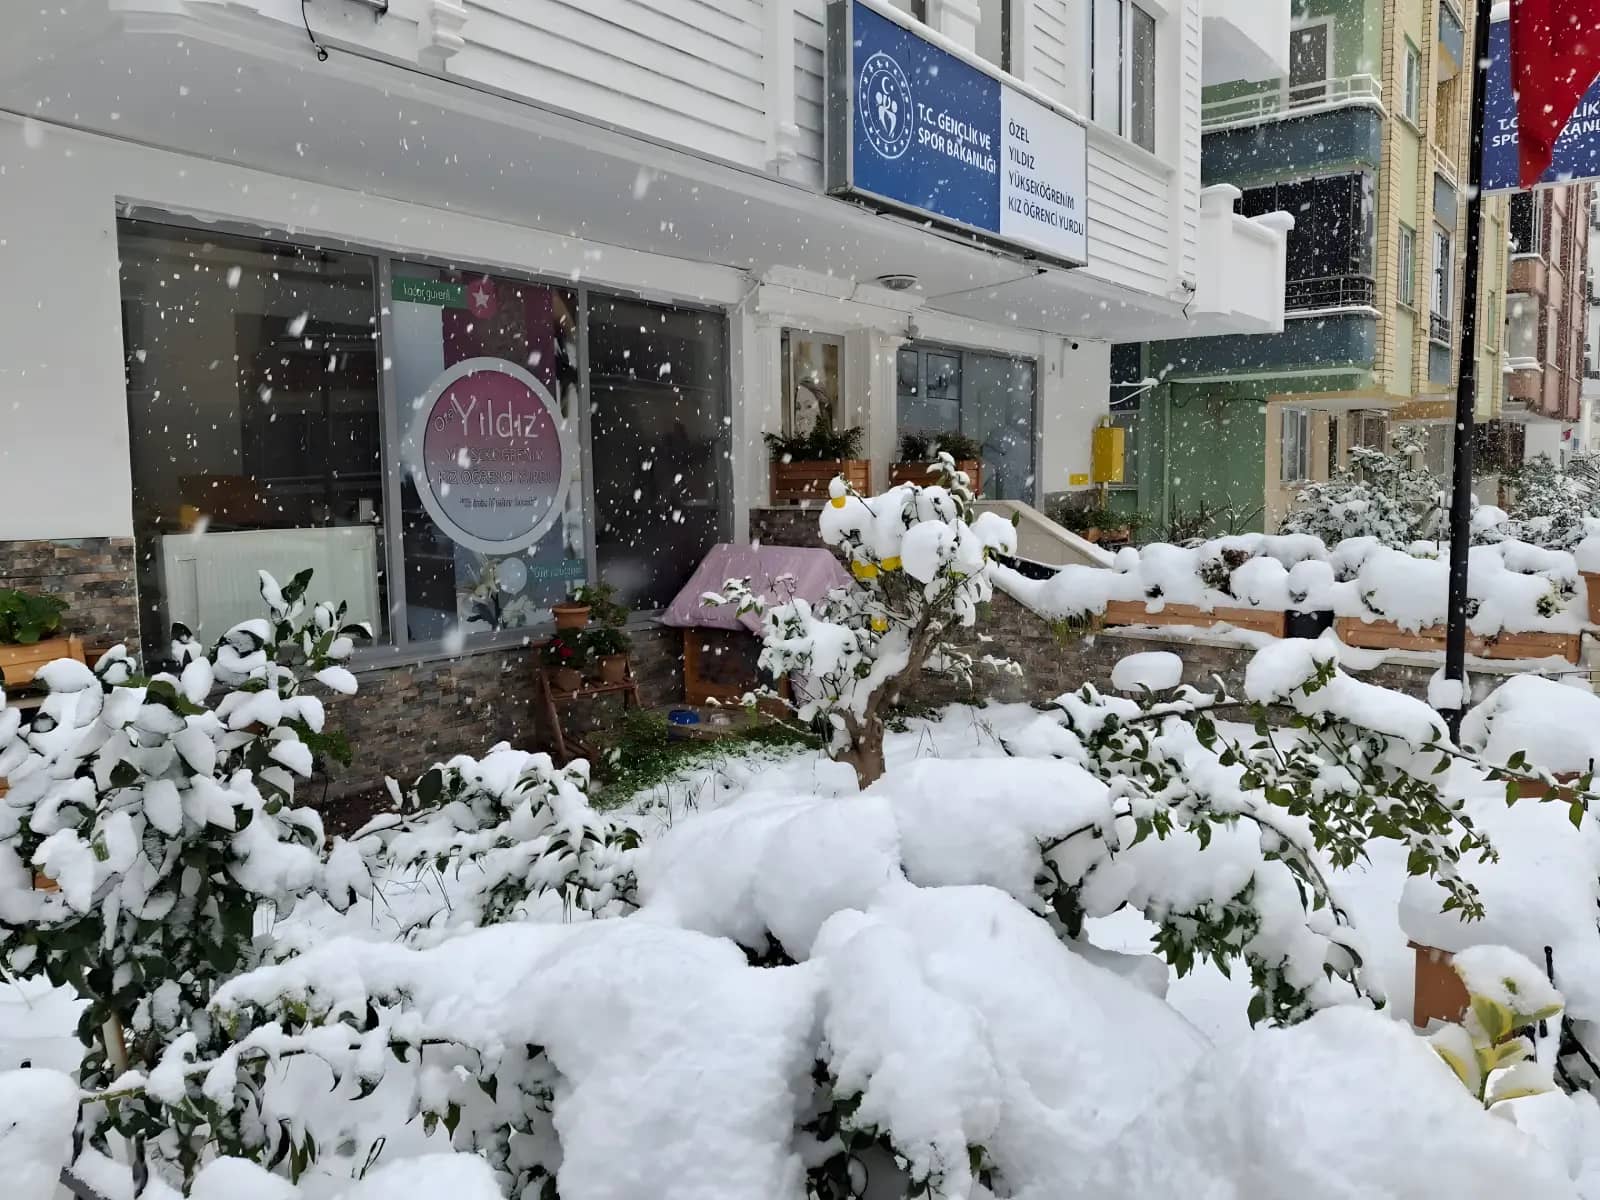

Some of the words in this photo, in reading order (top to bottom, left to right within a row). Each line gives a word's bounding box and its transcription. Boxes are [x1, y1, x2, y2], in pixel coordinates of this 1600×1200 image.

[917, 103, 936, 126] T.C.
[938, 113, 978, 145] GENÇLİK
[979, 132, 991, 151] VE
[1008, 118, 1030, 144] ÖZEL
[918, 127, 945, 153] SPOR
[947, 139, 996, 175] BAKANLIĞI
[1008, 145, 1035, 170] YILDIZ
[1008, 170, 1075, 210] YÜKSEKÖĞRENİM
[1008, 195, 1022, 214] KIZ
[1023, 198, 1058, 226] ÖĞRENCİ
[1059, 214, 1084, 236] YURDU
[450, 392, 538, 438] Yıldız
